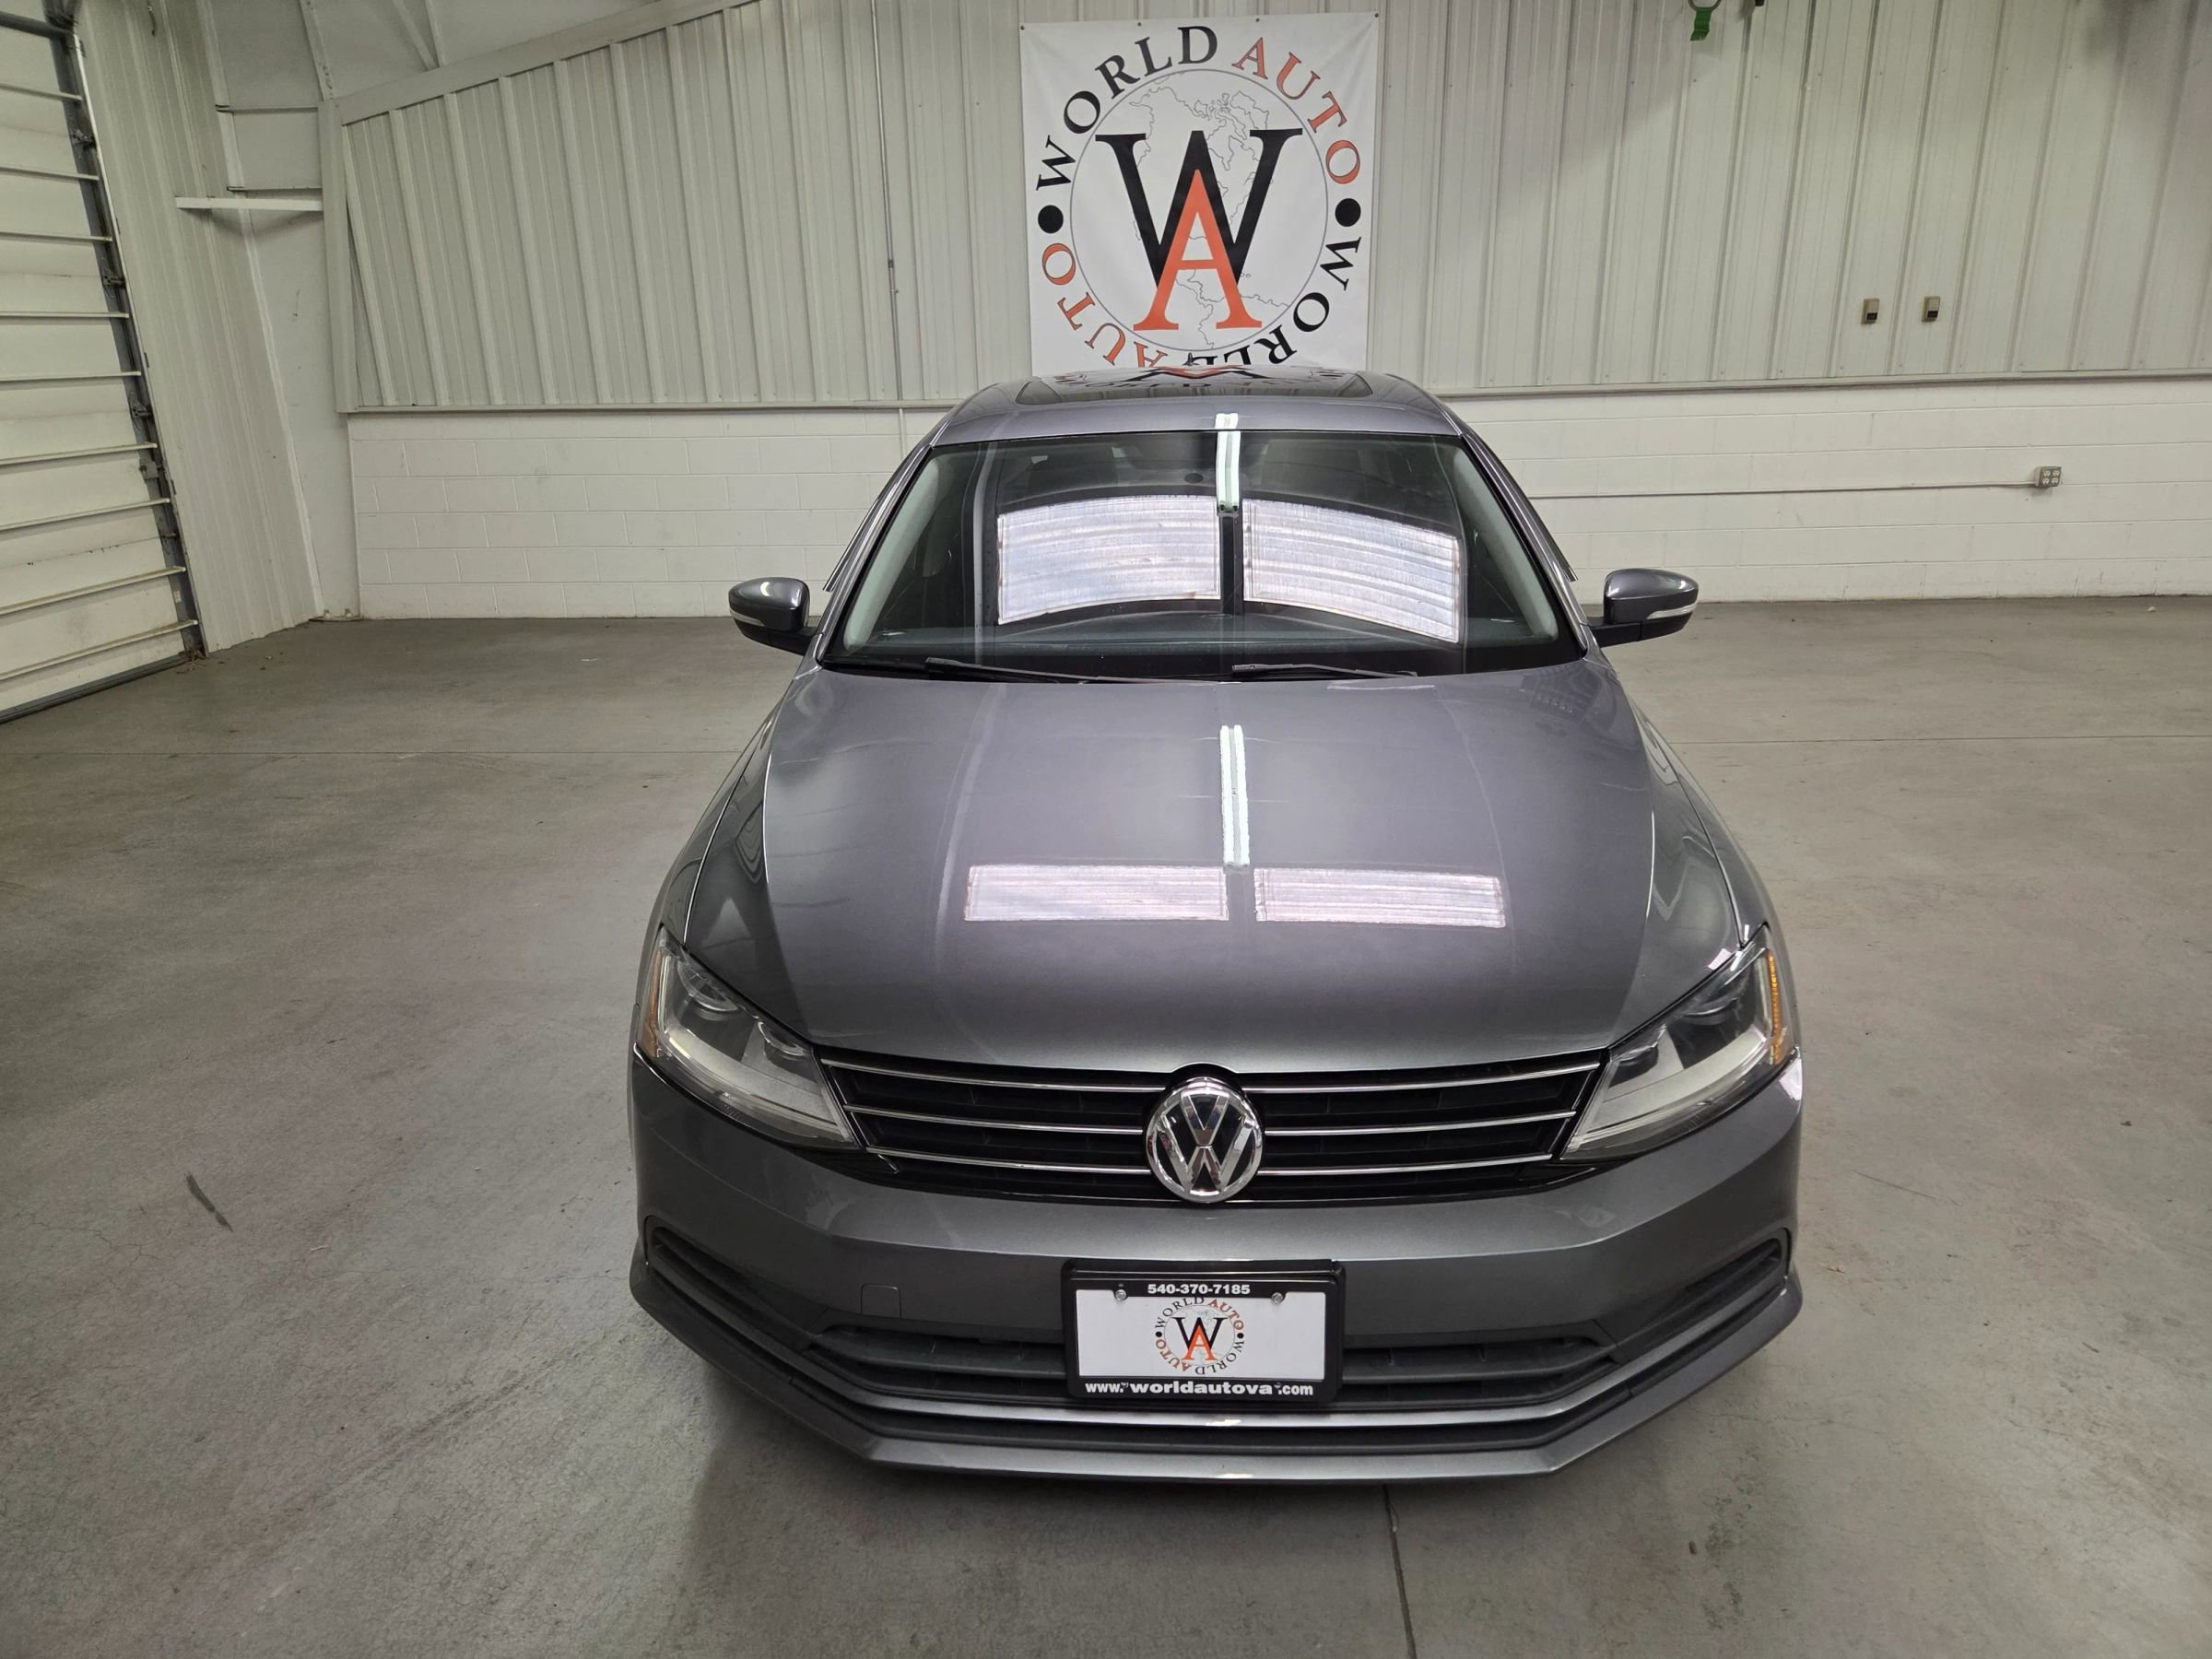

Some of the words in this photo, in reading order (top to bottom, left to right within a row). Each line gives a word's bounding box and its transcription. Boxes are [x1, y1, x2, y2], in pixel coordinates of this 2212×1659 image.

[1036, 25, 1218, 191] WORLD
[1231, 37, 1360, 184] AUTO
[1041, 242, 1169, 368] AUTO
[1147, 1283, 1251, 1295] 540-370-7185
[1155, 1296, 1205, 1329] WORLD
[1208, 1299, 1244, 1331] AUTO
[1155, 1338, 1192, 1372] AUTO
[1194, 1340, 1245, 1375] WORLD
